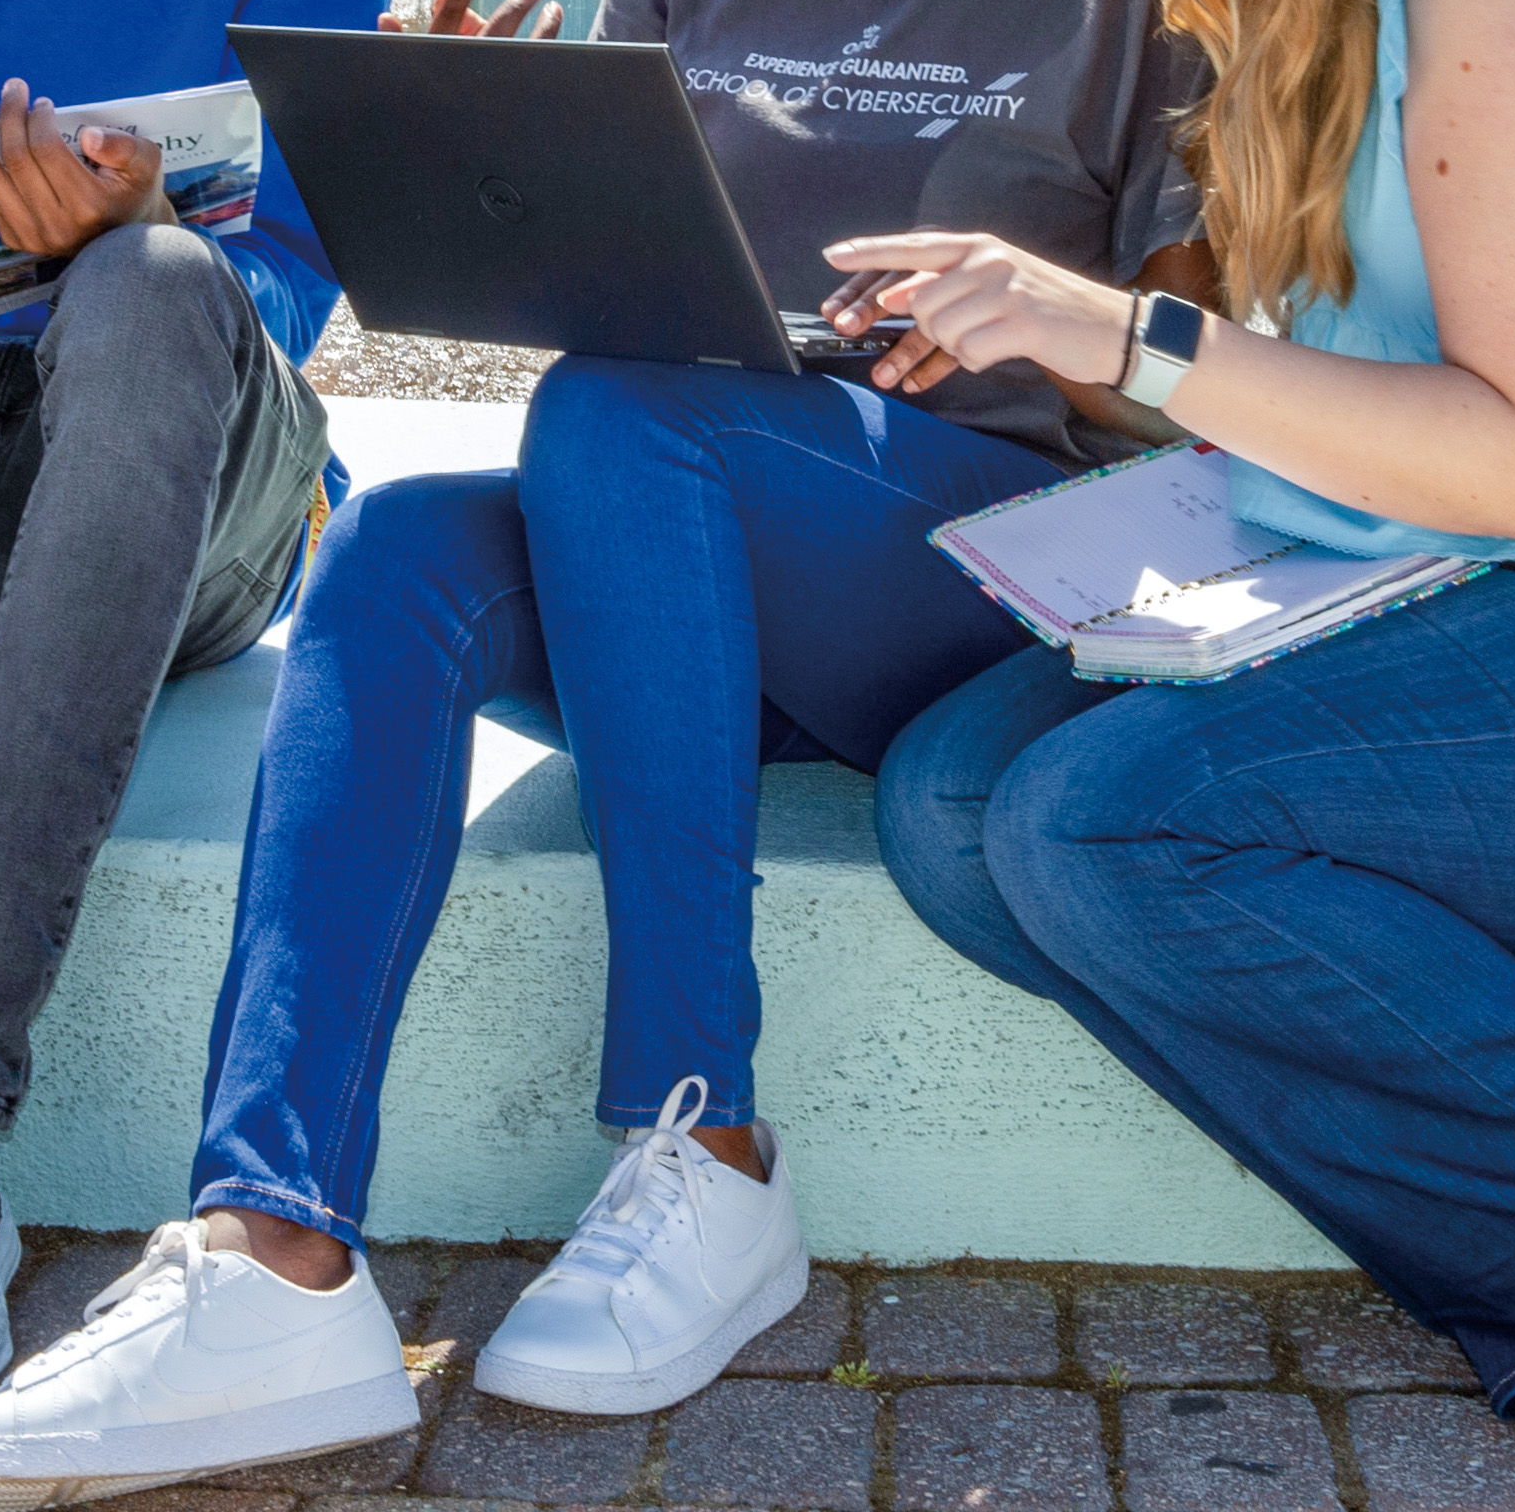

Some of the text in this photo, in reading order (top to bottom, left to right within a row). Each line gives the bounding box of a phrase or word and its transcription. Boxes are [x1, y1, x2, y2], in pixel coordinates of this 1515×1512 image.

[744, 53, 969, 84] EXPERIENCE GUARANTEED.
[686, 68, 1026, 120] SCHOOL OF CYBERSECURITY
